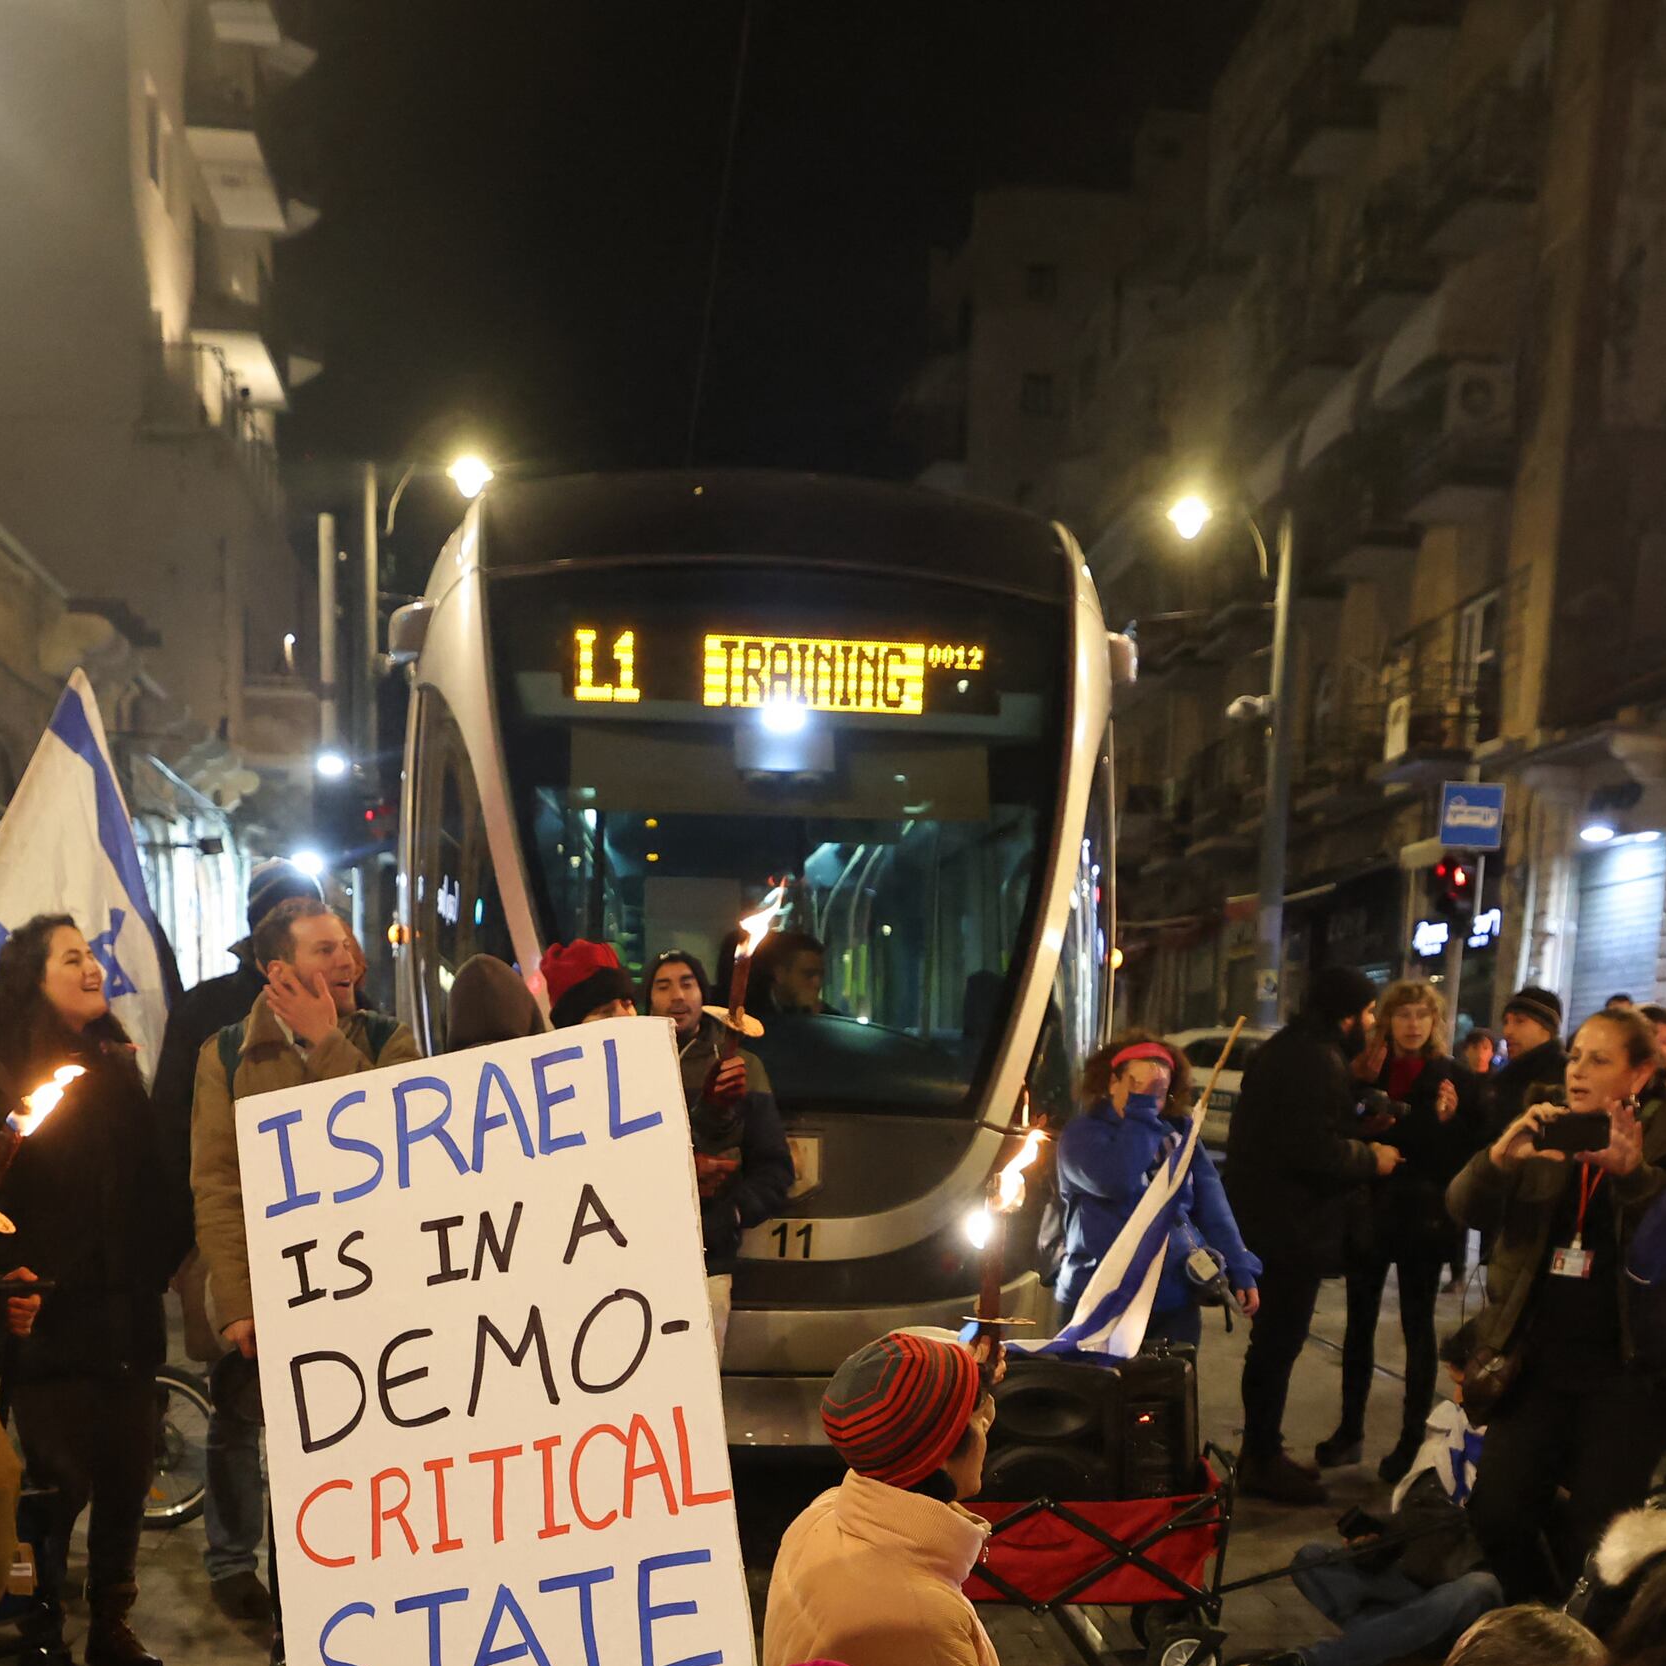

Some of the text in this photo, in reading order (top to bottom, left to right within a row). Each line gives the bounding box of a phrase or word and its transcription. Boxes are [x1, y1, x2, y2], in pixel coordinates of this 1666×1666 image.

[574, 628, 640, 703] L1
[719, 638, 909, 710] TRAINING
[258, 1039, 663, 1218] ISRAEL
[282, 1183, 627, 1308] IS IN A
[771, 1222, 815, 1259] 11
[290, 1288, 690, 1454] DEMO-
[295, 1406, 733, 1568] CRITICAL
